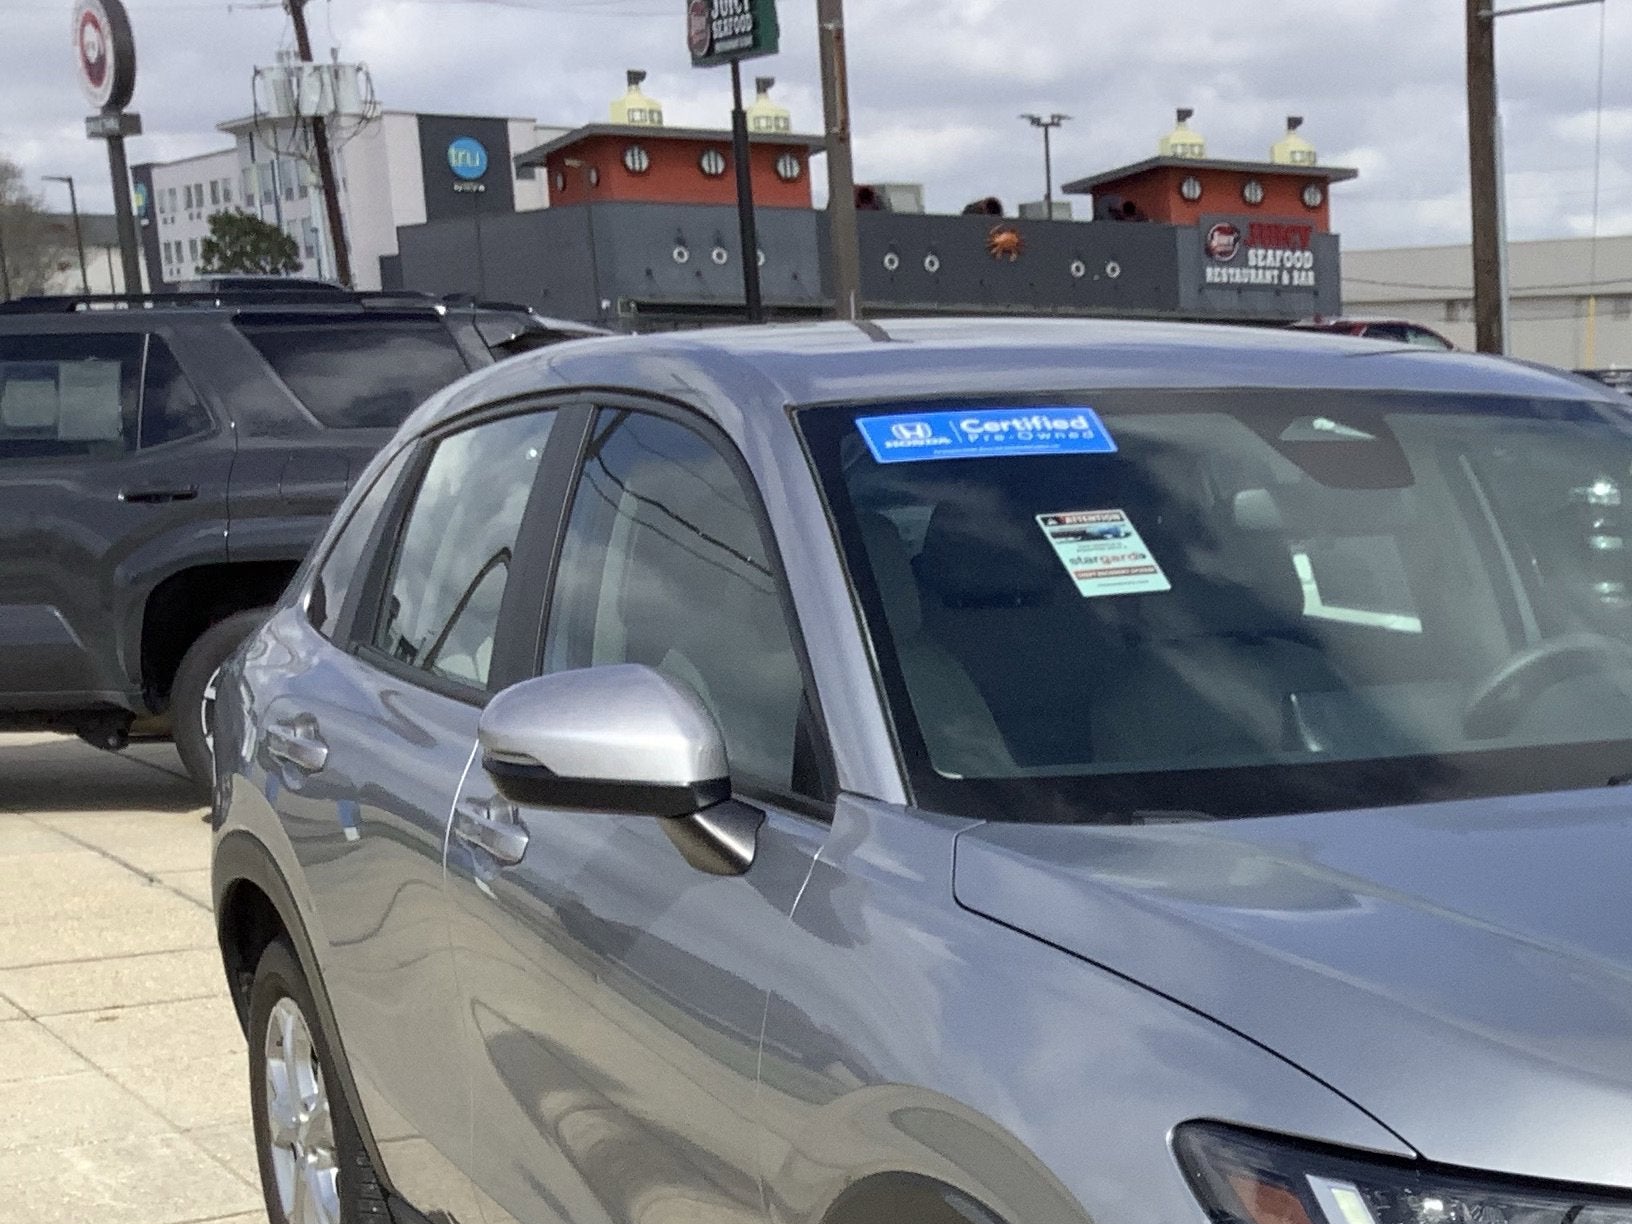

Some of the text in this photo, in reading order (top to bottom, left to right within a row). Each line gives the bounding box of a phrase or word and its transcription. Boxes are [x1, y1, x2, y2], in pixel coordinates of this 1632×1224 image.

[712, 13, 752, 40] SEAFOOD
[449, 145, 480, 168] tru
[1247, 249, 1314, 269] SEAFOOD
[1205, 266, 1279, 284] RESTAURANT
[1292, 269, 1316, 286] BAR
[960, 416, 1089, 434] Certified
[885, 437, 953, 448] HONDA
[967, 431, 1094, 443] Pre-Owned
[1065, 512, 1122, 524] ATTENTION
